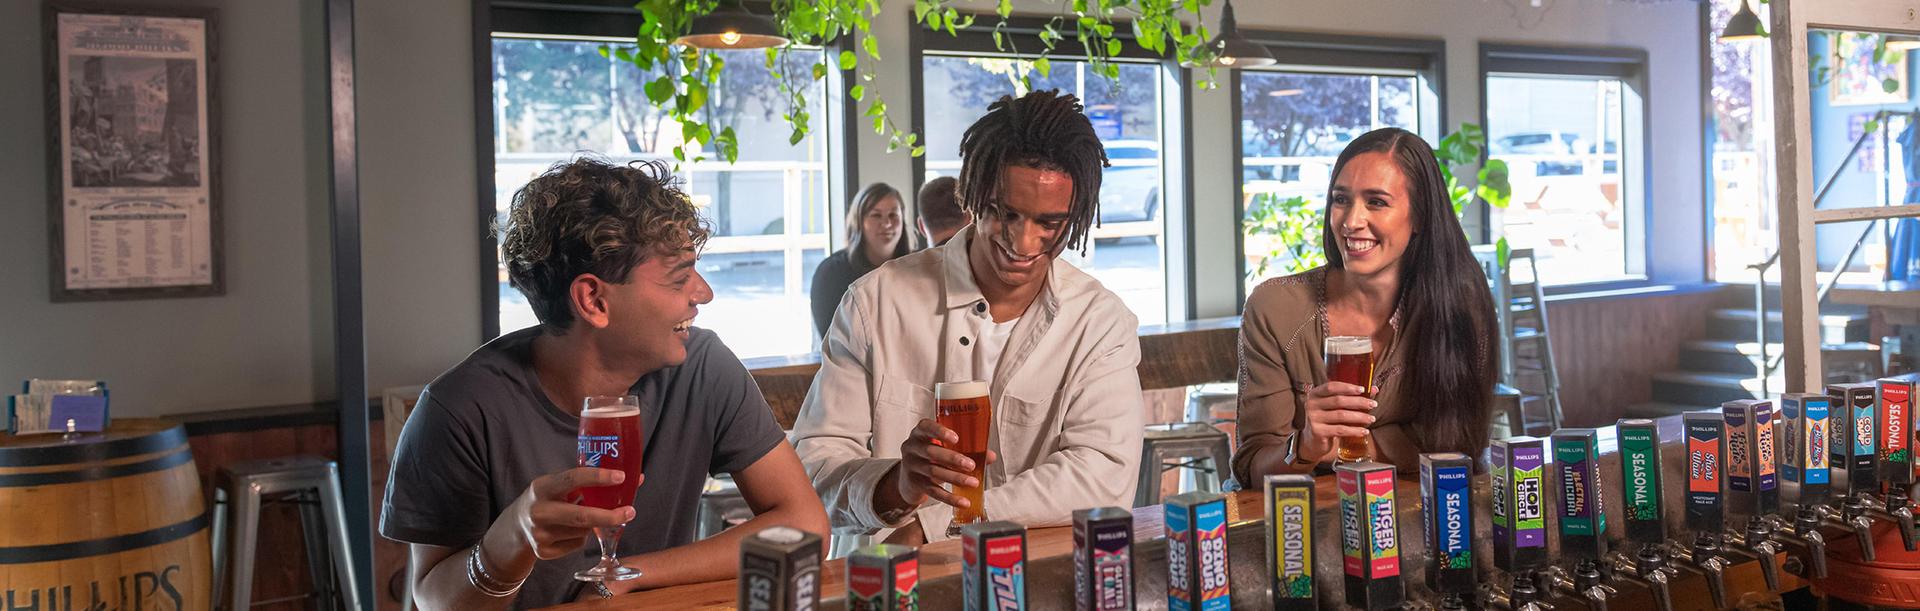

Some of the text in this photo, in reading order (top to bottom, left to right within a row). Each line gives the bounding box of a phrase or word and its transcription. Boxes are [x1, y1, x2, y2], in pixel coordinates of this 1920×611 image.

[1864, 416, 1873, 446] COLD
[1889, 404, 1901, 449] SEASONAL
[1368, 477, 1392, 485] PHILLIPS
[1632, 453, 1648, 505] SEASONAL
[1692, 450, 1702, 480] Wave
[1705, 451, 1717, 481] Short
[1517, 483, 1527, 519] CIRCLE
[1526, 480, 1539, 516] HOP
[1572, 471, 1585, 513] ELECTRIC
[1097, 531, 1128, 541] PHILLIPS
[1283, 505, 1304, 578] SEASONAL
[1380, 499, 1395, 550] TIGER
[1446, 493, 1462, 552] SEASONAL
[1169, 538, 1179, 588] SOUR
[1178, 541, 1188, 589] DINO
[1201, 538, 1215, 591] SOUR
[1212, 536, 1226, 587] DINO
[1115, 565, 1125, 608] GLITTER
